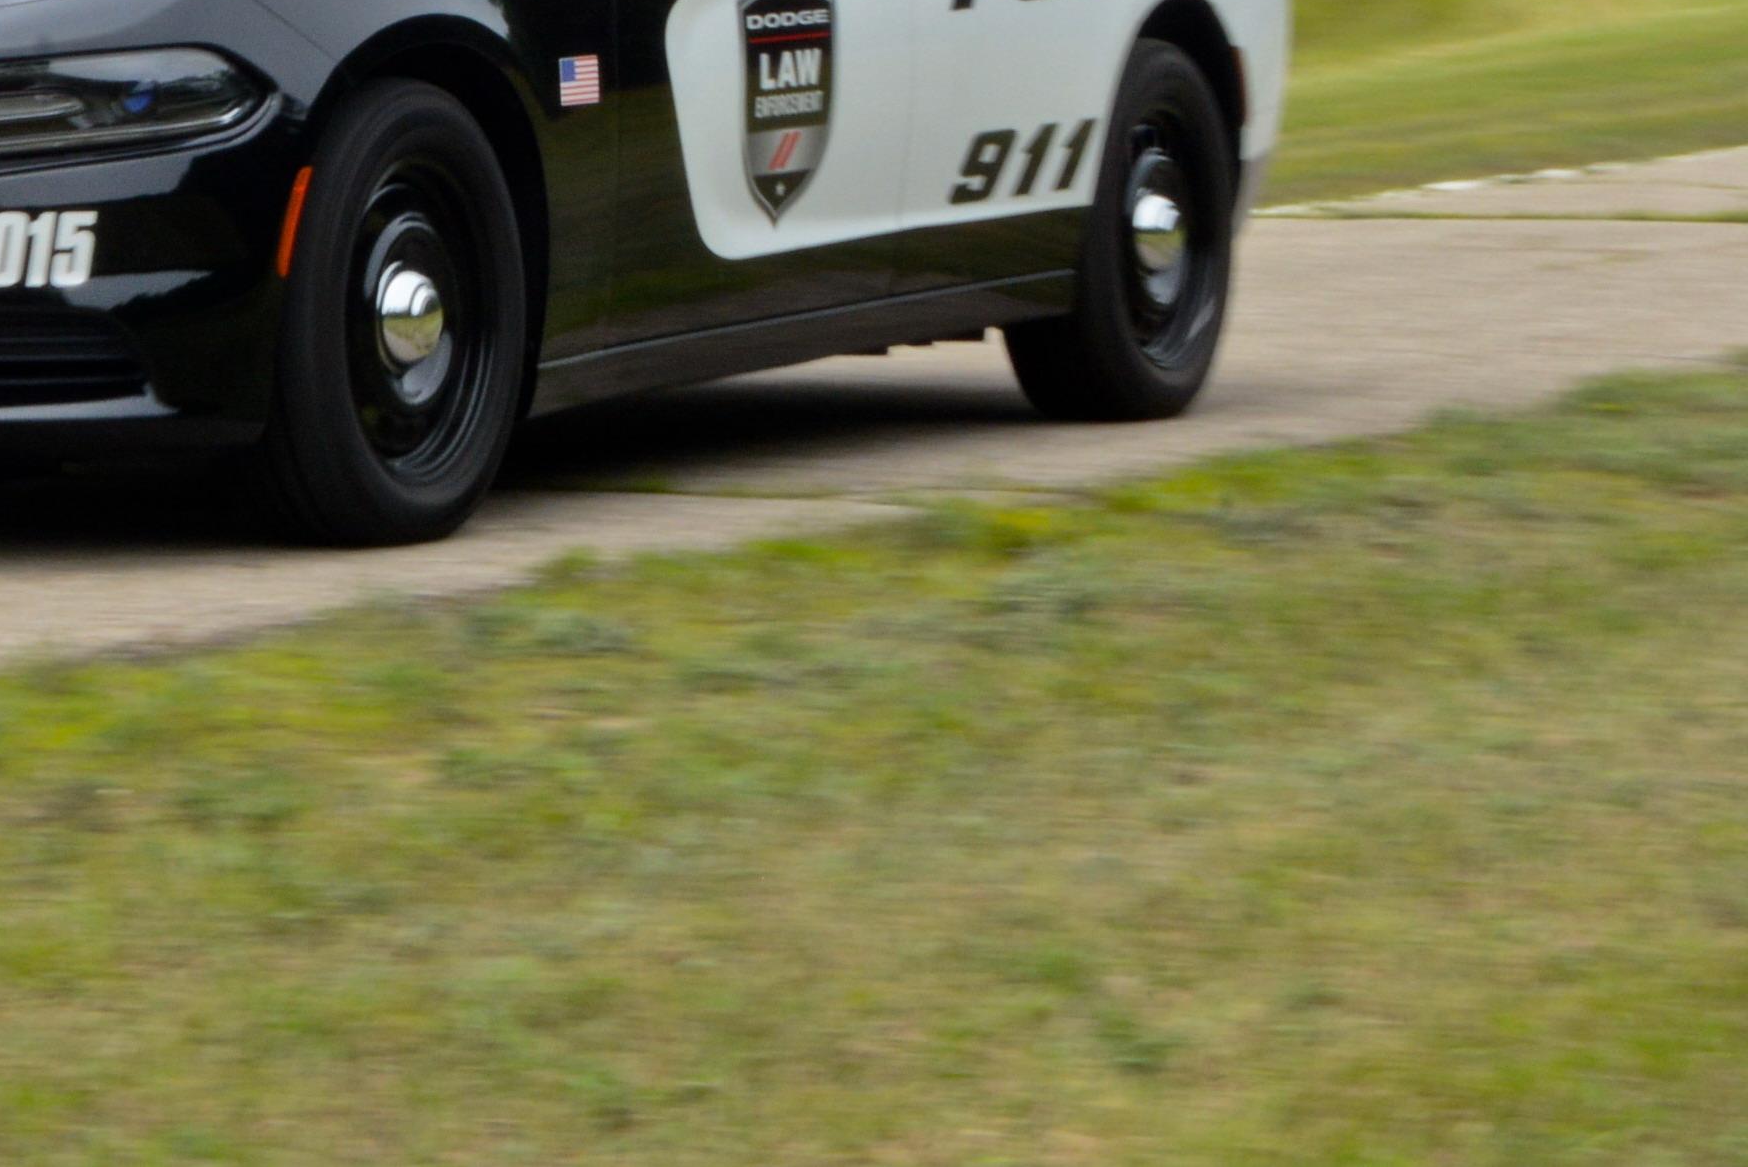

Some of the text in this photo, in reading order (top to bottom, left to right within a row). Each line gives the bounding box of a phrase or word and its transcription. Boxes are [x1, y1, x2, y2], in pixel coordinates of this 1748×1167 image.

[745, 8, 831, 30] DODGE
[758, 47, 823, 90] LAW
[947, 118, 1098, 205] 911
